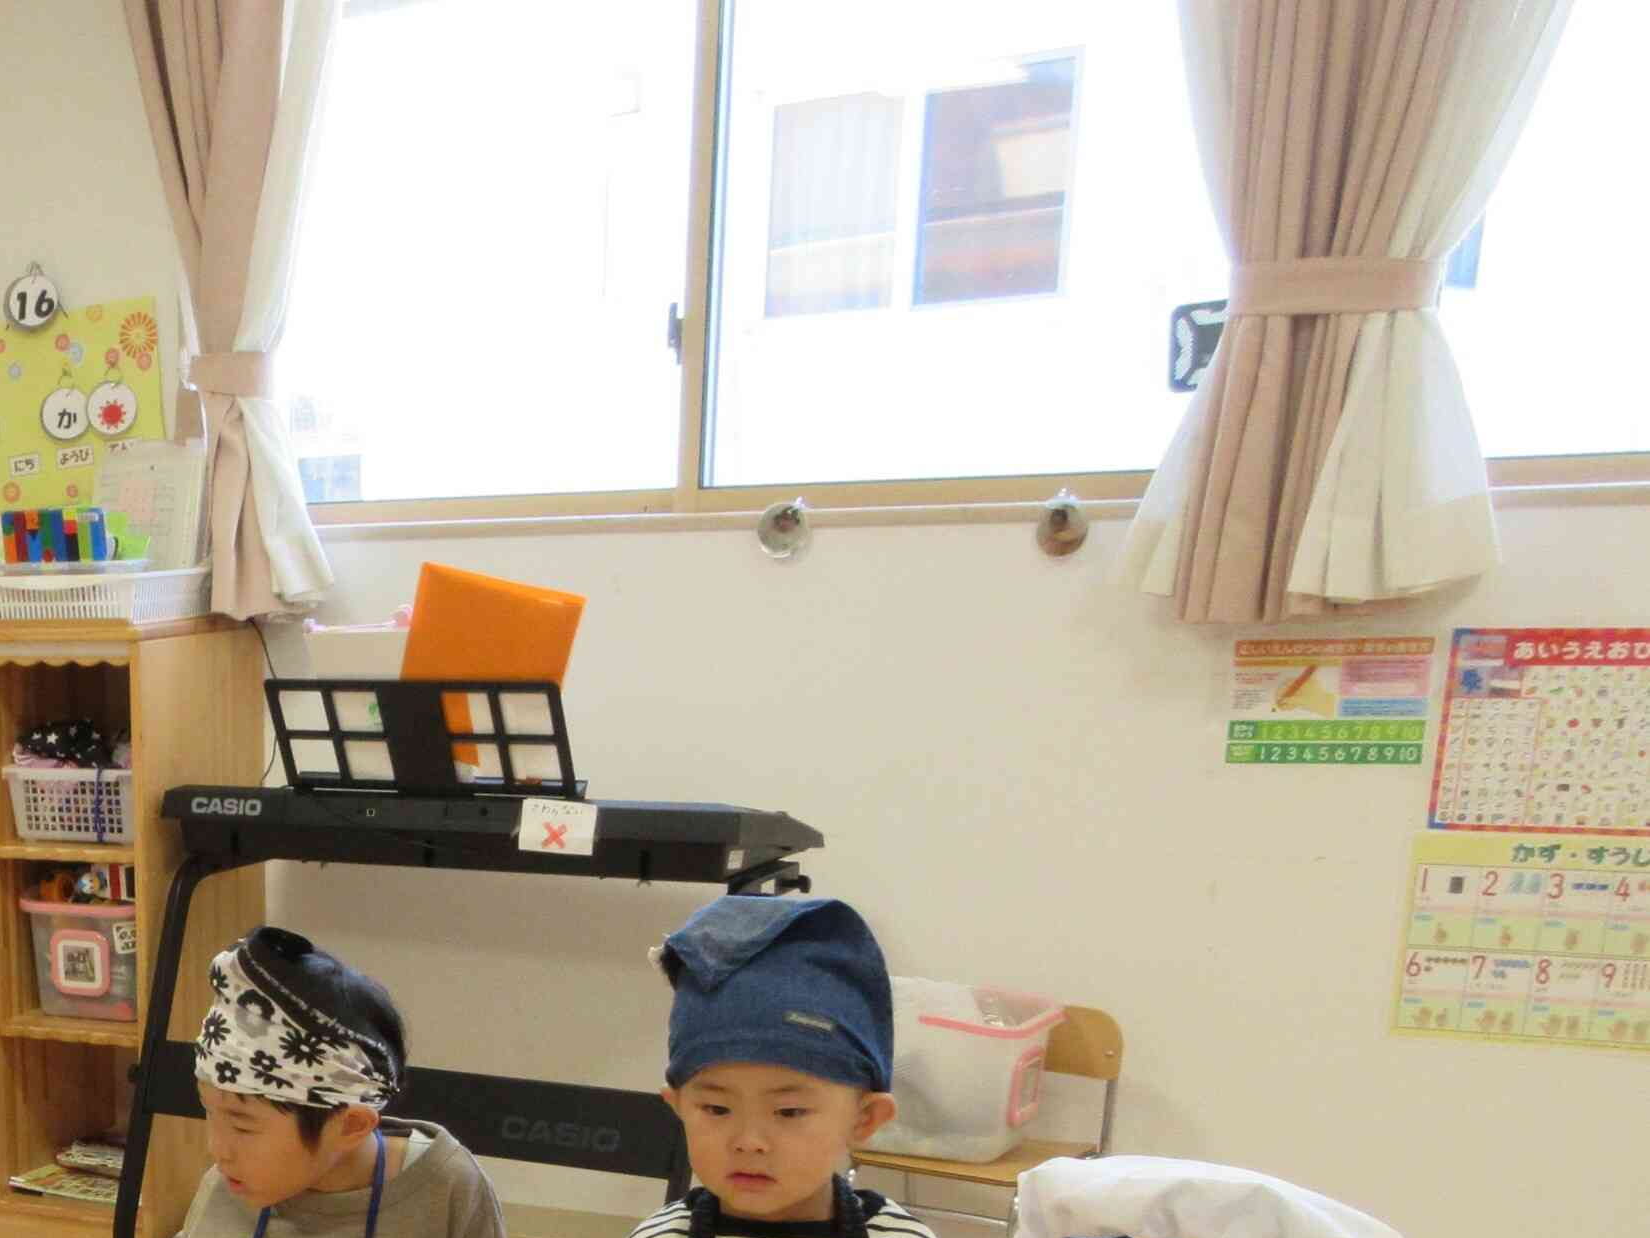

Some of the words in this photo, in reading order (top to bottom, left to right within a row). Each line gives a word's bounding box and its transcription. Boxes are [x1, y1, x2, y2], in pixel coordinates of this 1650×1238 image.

[16, 289, 55, 321] 16
[57, 408, 77, 429] か
[13, 459, 36, 473] にち
[1260, 746, 1267, 762] 1
[1270, 746, 1280, 762] 2
[1286, 746, 1297, 762] 3
[1302, 746, 1315, 762] 4
[1318, 746, 1330, 762] 5
[1334, 746, 1346, 762] 6
[1350, 746, 1361, 762] 7
[1366, 746, 1379, 762] 8
[1383, 746, 1396, 762] 9
[1400, 746, 1417, 762] 10
[191, 797, 262, 816] CASIO
[1421, 867, 1428, 893] 1
[1482, 871, 1498, 896] 2
[1547, 873, 1564, 899] 3
[1614, 877, 1630, 901] 4
[1406, 952, 1421, 977] 6
[1471, 955, 1486, 979] 7
[1535, 959, 1551, 984] 8
[1602, 963, 1616, 988] 9
[502, 1115, 621, 1153] CASIO
